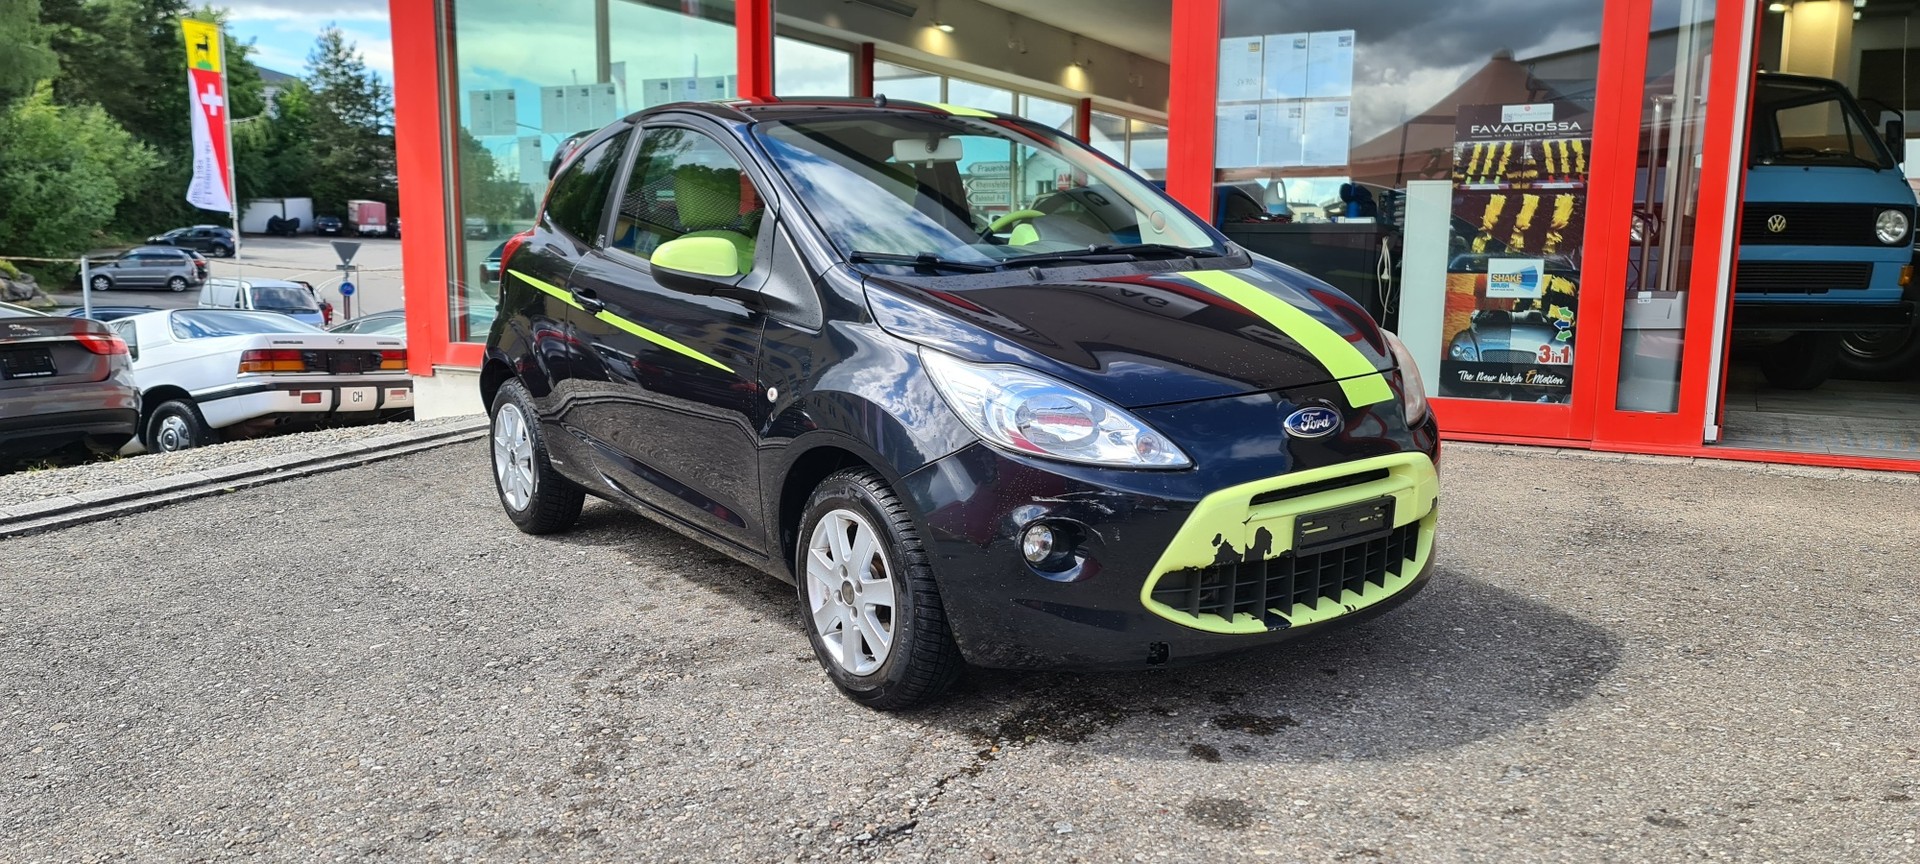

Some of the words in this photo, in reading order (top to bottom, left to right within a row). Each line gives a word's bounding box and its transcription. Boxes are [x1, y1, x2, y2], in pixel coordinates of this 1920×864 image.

[1470, 121, 1582, 134] FAVAGROSSA
[1491, 273, 1522, 283] SHAKE
[1538, 345, 1570, 364] 3in1
[1458, 370, 1475, 381] The
[1476, 371, 1497, 381] New
[1498, 371, 1523, 385] Wash
[352, 391, 363, 403] CH
[1301, 412, 1331, 431] Ford
